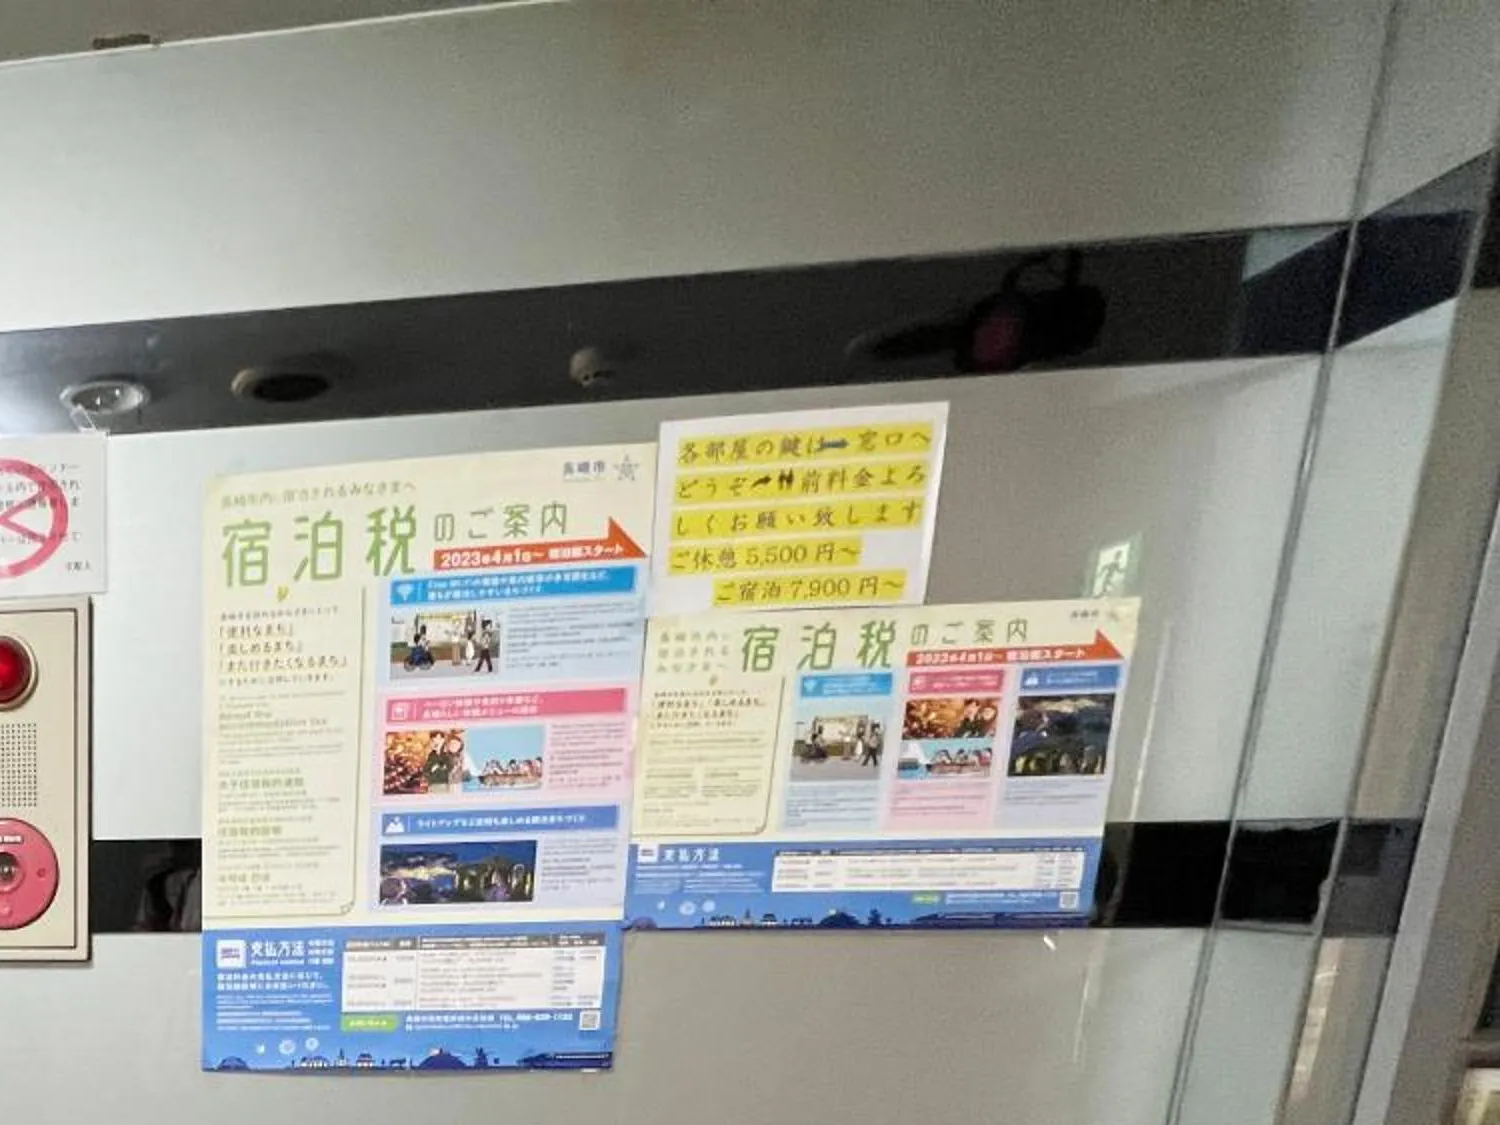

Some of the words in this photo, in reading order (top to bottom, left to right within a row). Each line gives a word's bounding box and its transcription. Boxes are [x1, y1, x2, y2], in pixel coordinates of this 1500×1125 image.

[678, 437, 821, 464] 各部屋の鍵は
[857, 430, 931, 450] 窓口へ
[677, 476, 747, 498] どうぞ
[802, 466, 926, 494] 前料金よろ
[676, 502, 921, 536] しくお願い致します
